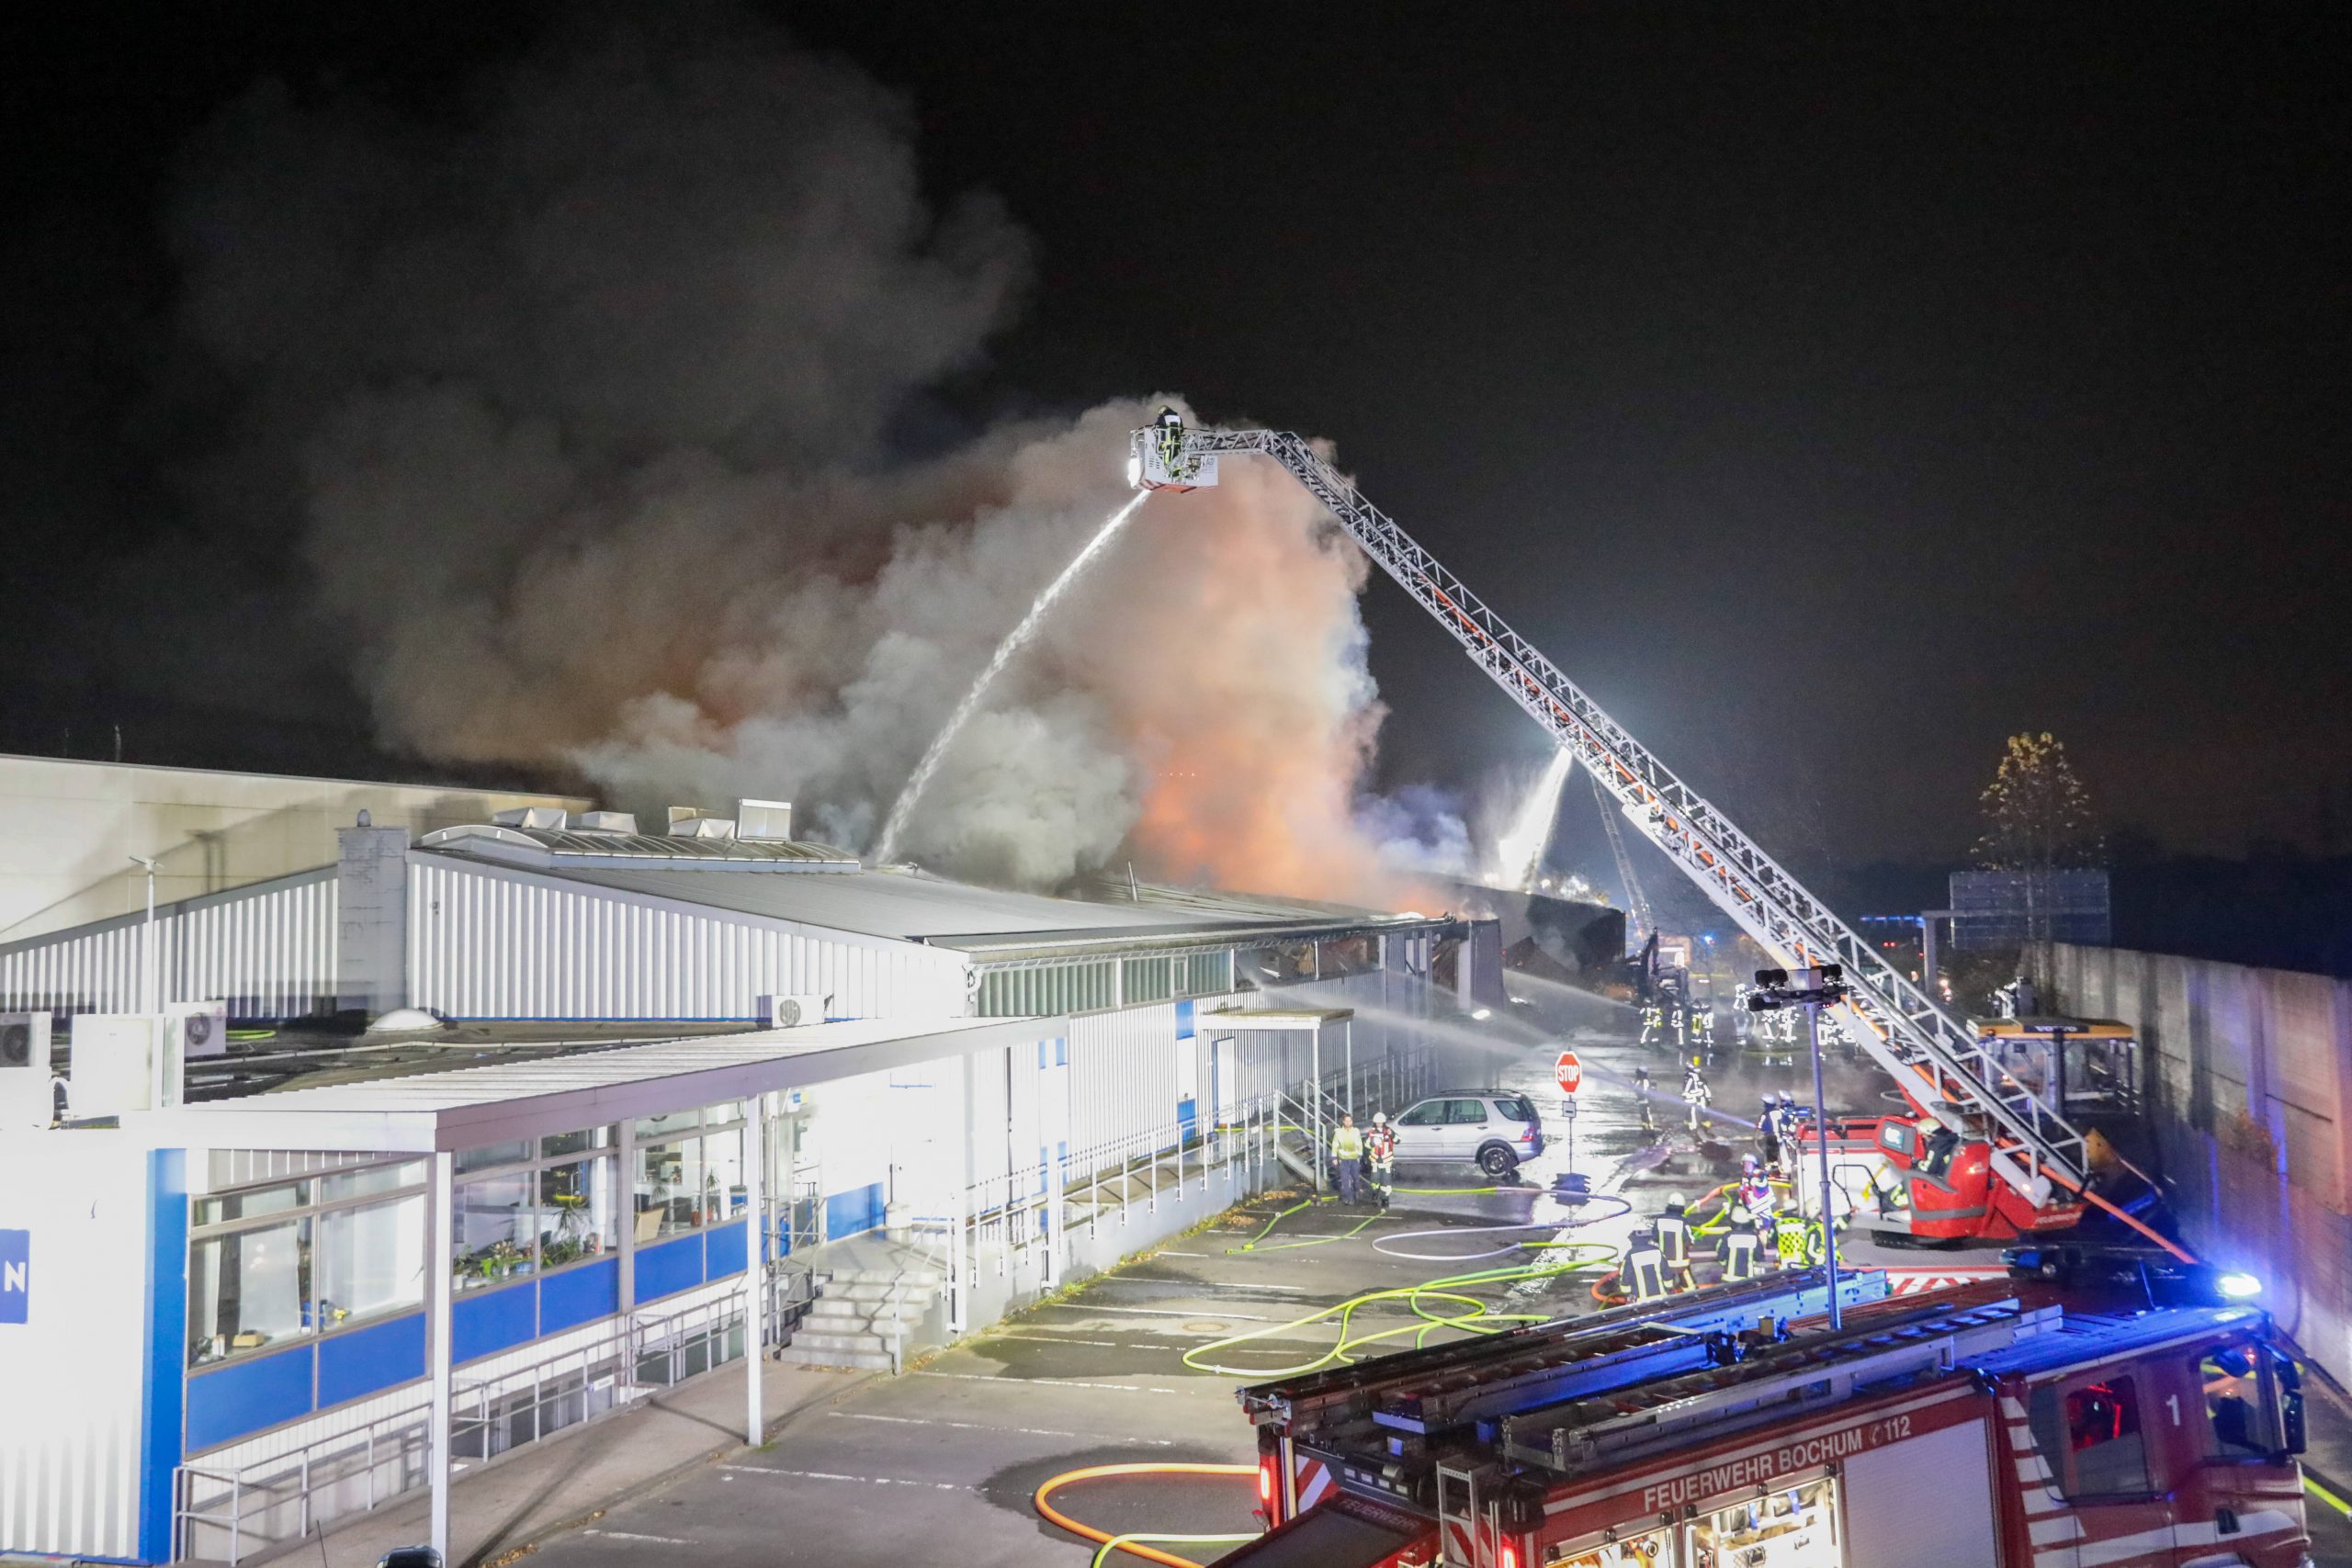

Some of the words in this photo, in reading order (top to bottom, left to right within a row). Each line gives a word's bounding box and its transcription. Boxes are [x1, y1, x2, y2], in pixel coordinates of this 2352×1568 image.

[1558, 1065, 1579, 1082] STOP
[2165, 1394, 2180, 1426] 1
[1645, 1457, 1772, 1512] FEUERWEHR
[1779, 1428, 1862, 1472] BOCHUM
[1883, 1416, 1911, 1440] 112
[1339, 1498, 1420, 1529] FEUERWEHR
